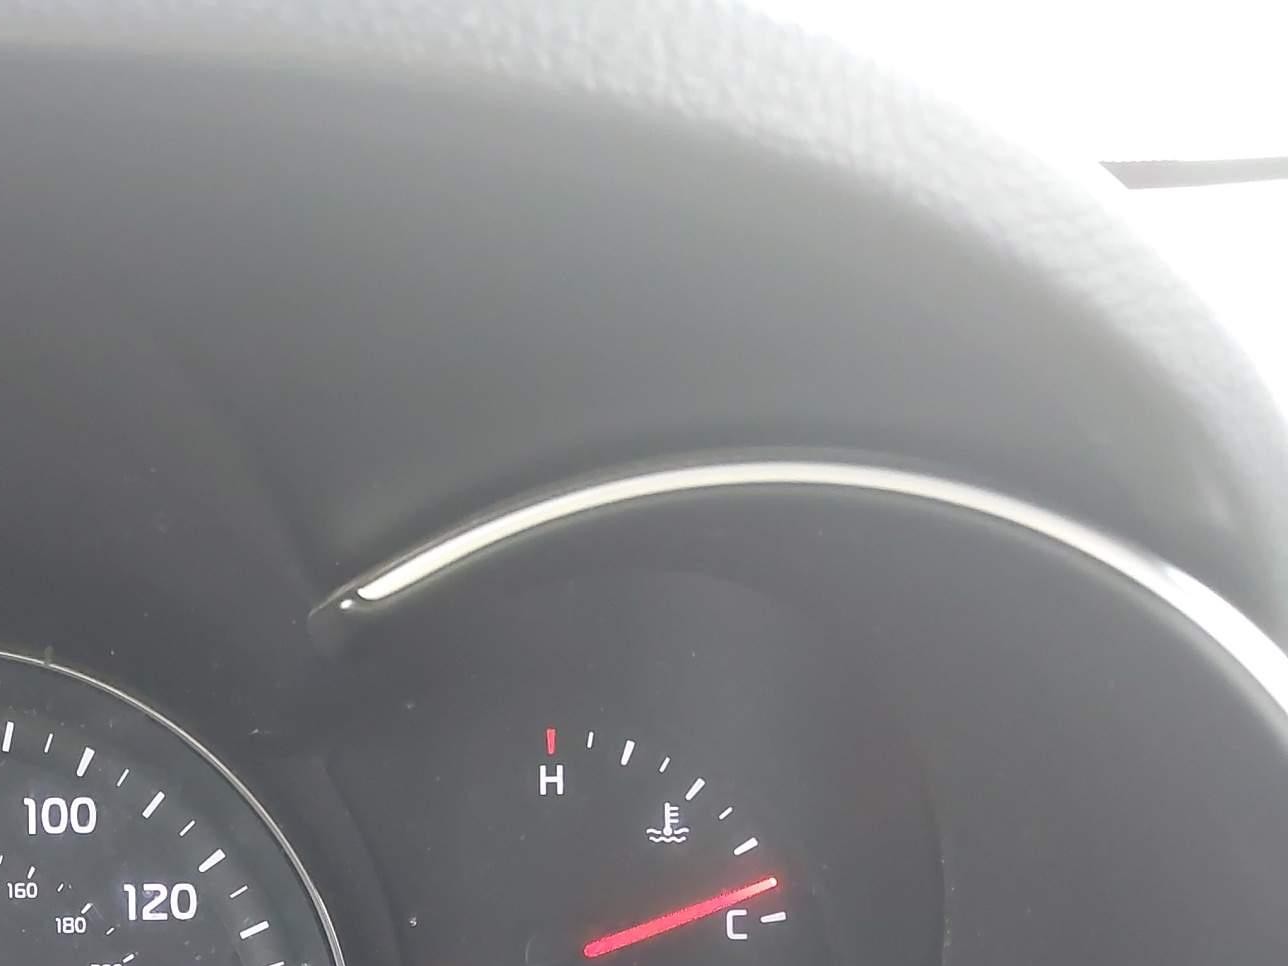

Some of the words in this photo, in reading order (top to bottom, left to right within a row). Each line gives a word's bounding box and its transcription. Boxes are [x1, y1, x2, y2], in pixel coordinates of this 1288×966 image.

[539, 764, 564, 796] H
[23, 796, 97, 835] 100
[7, 882, 38, 899] 160
[123, 883, 198, 921] 120
[55, 916, 87, 934] 180
[726, 909, 748, 940] C
